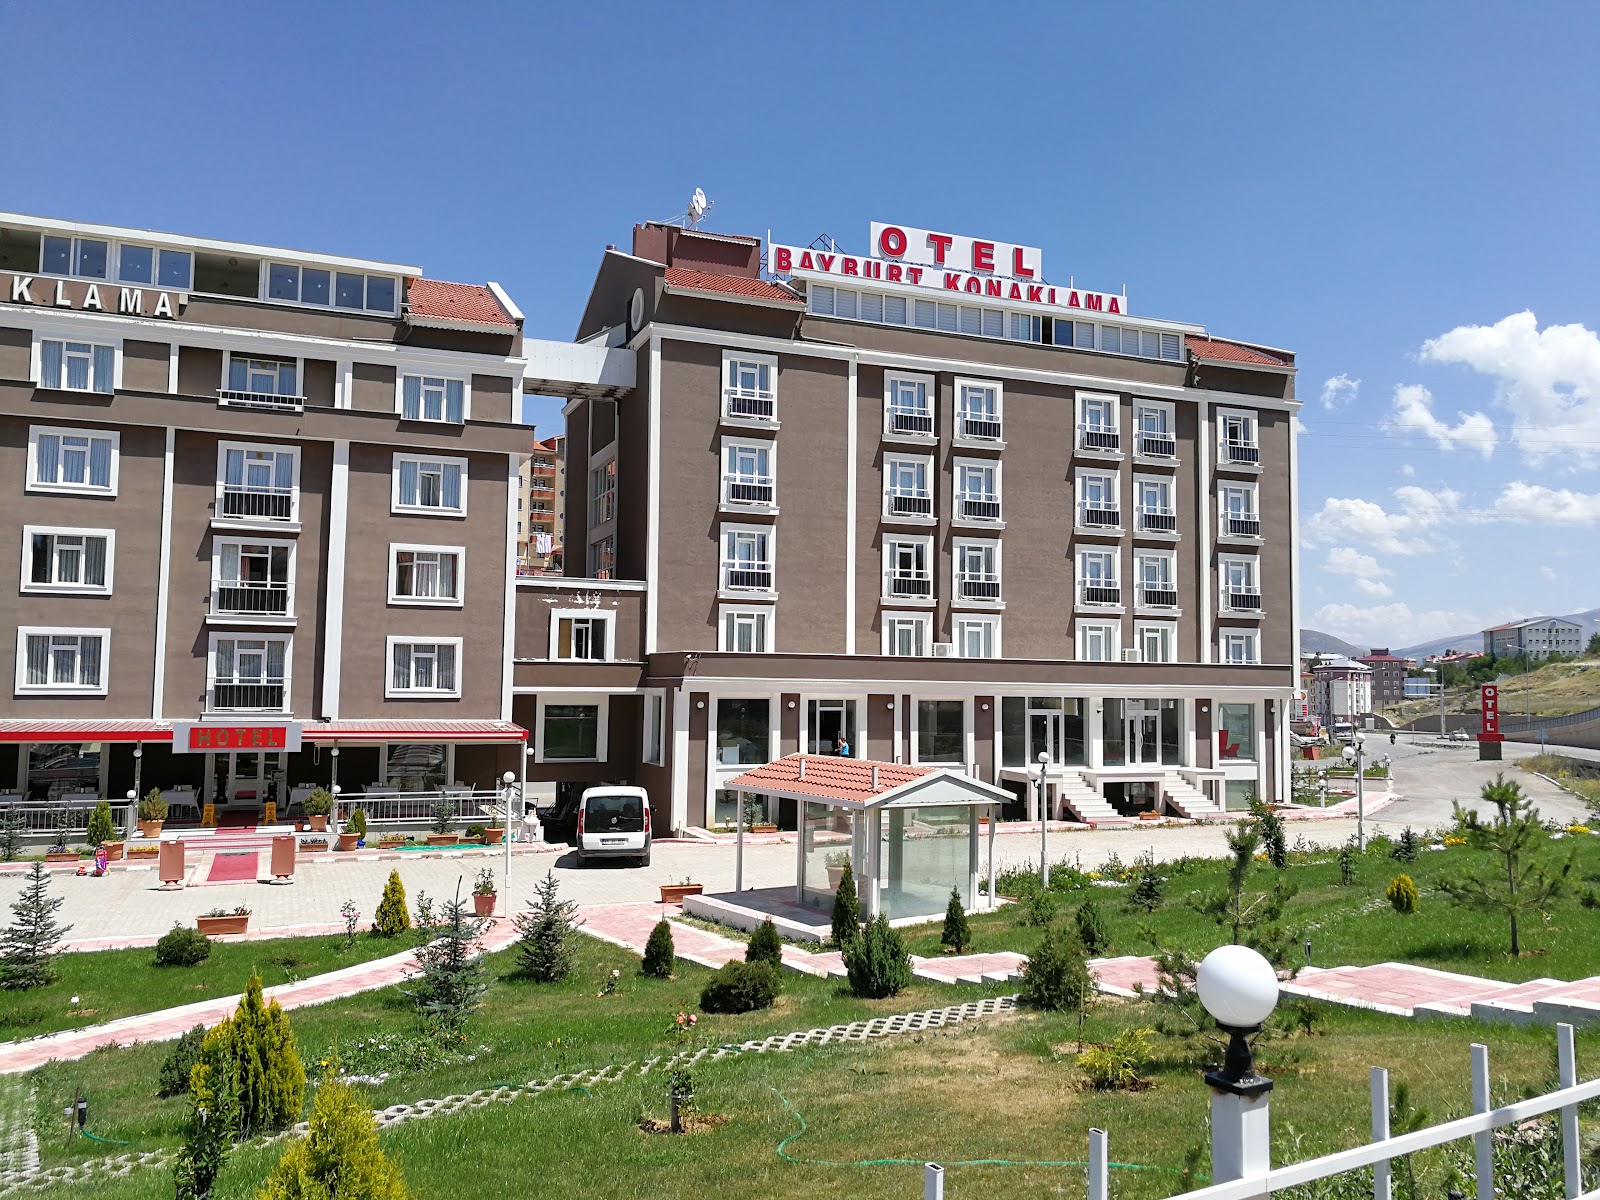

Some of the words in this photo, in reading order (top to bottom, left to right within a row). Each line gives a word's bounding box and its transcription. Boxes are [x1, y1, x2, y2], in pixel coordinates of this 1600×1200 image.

[879, 226, 1035, 278] OTEL
[944, 272, 1121, 314] KONAKLAMA
[1484, 687, 1495, 732] OTEL
[197, 729, 278, 746] HOTEL
